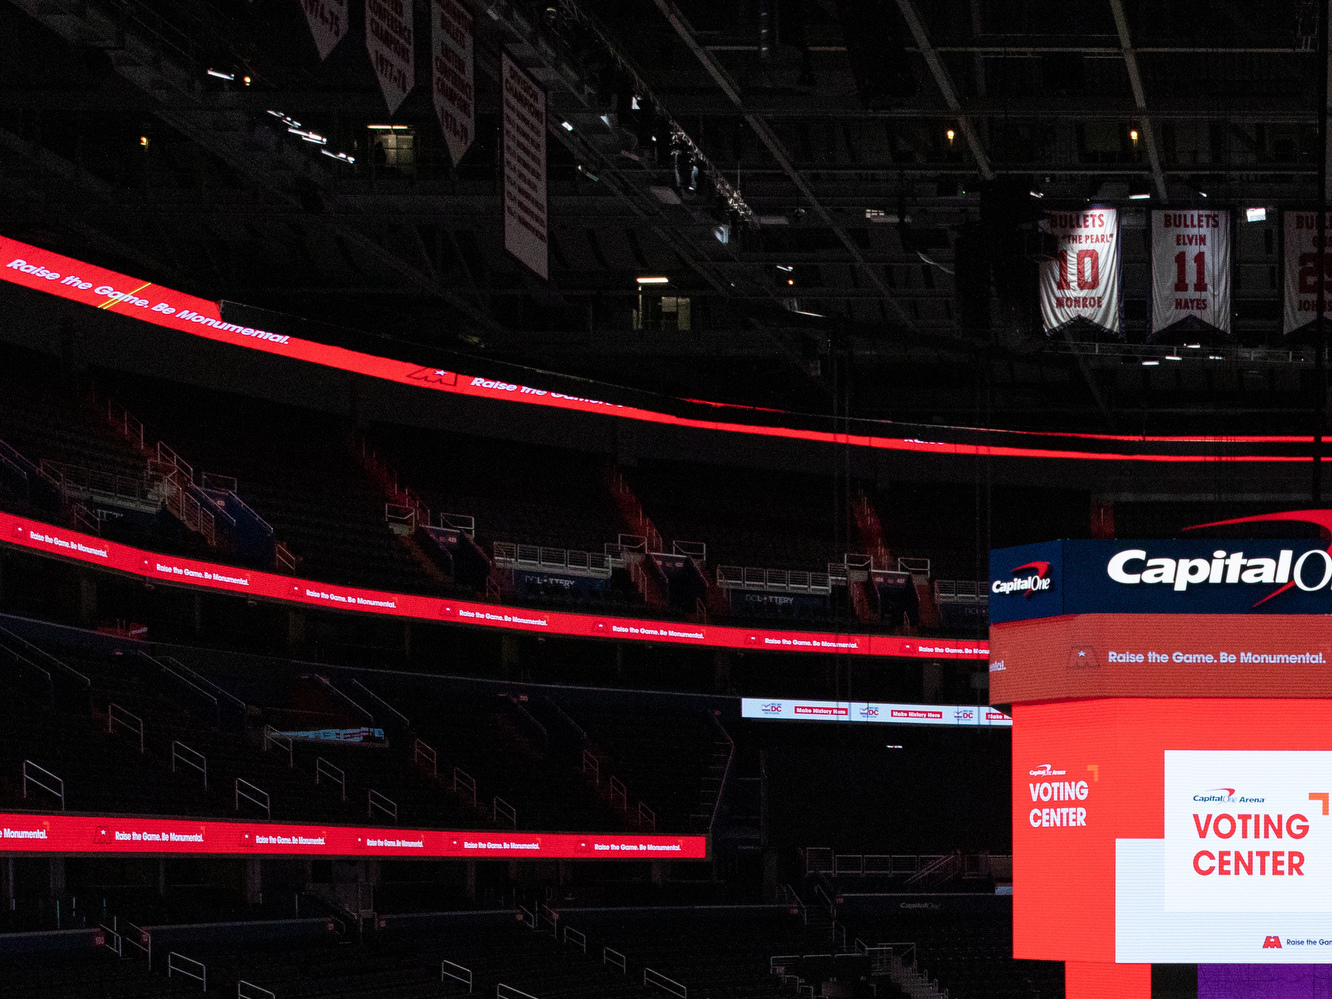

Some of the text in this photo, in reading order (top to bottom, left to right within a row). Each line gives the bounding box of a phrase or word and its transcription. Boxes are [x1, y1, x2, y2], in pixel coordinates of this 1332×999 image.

[1051, 213, 1105, 229] BULLETS
[1163, 213, 1220, 229] BULLETS
[1175, 234, 1207, 246] ELVIN
[1056, 249, 1100, 291] 10
[1174, 250, 1208, 292] 11
[7, 259, 289, 344] Raise the Game. Be Monumental.
[1056, 296, 1103, 309] MONROE
[1174, 297, 1208, 311] HAYES
[157, 564, 172, 573] Raise
[173, 567, 183, 575] the
[184, 568, 204, 578] Game.
[213, 573, 249, 585] Monumental.
[1108, 651, 1326, 664] Raise the Game. Be Monumental.
[1029, 780, 1089, 802] VOTING
[1029, 807, 1087, 828] CENTER
[1192, 813, 1310, 840] VOTING
[115, 831, 204, 842] Raise the Game. Be Monumental.
[1193, 849, 1305, 876] CENTER
